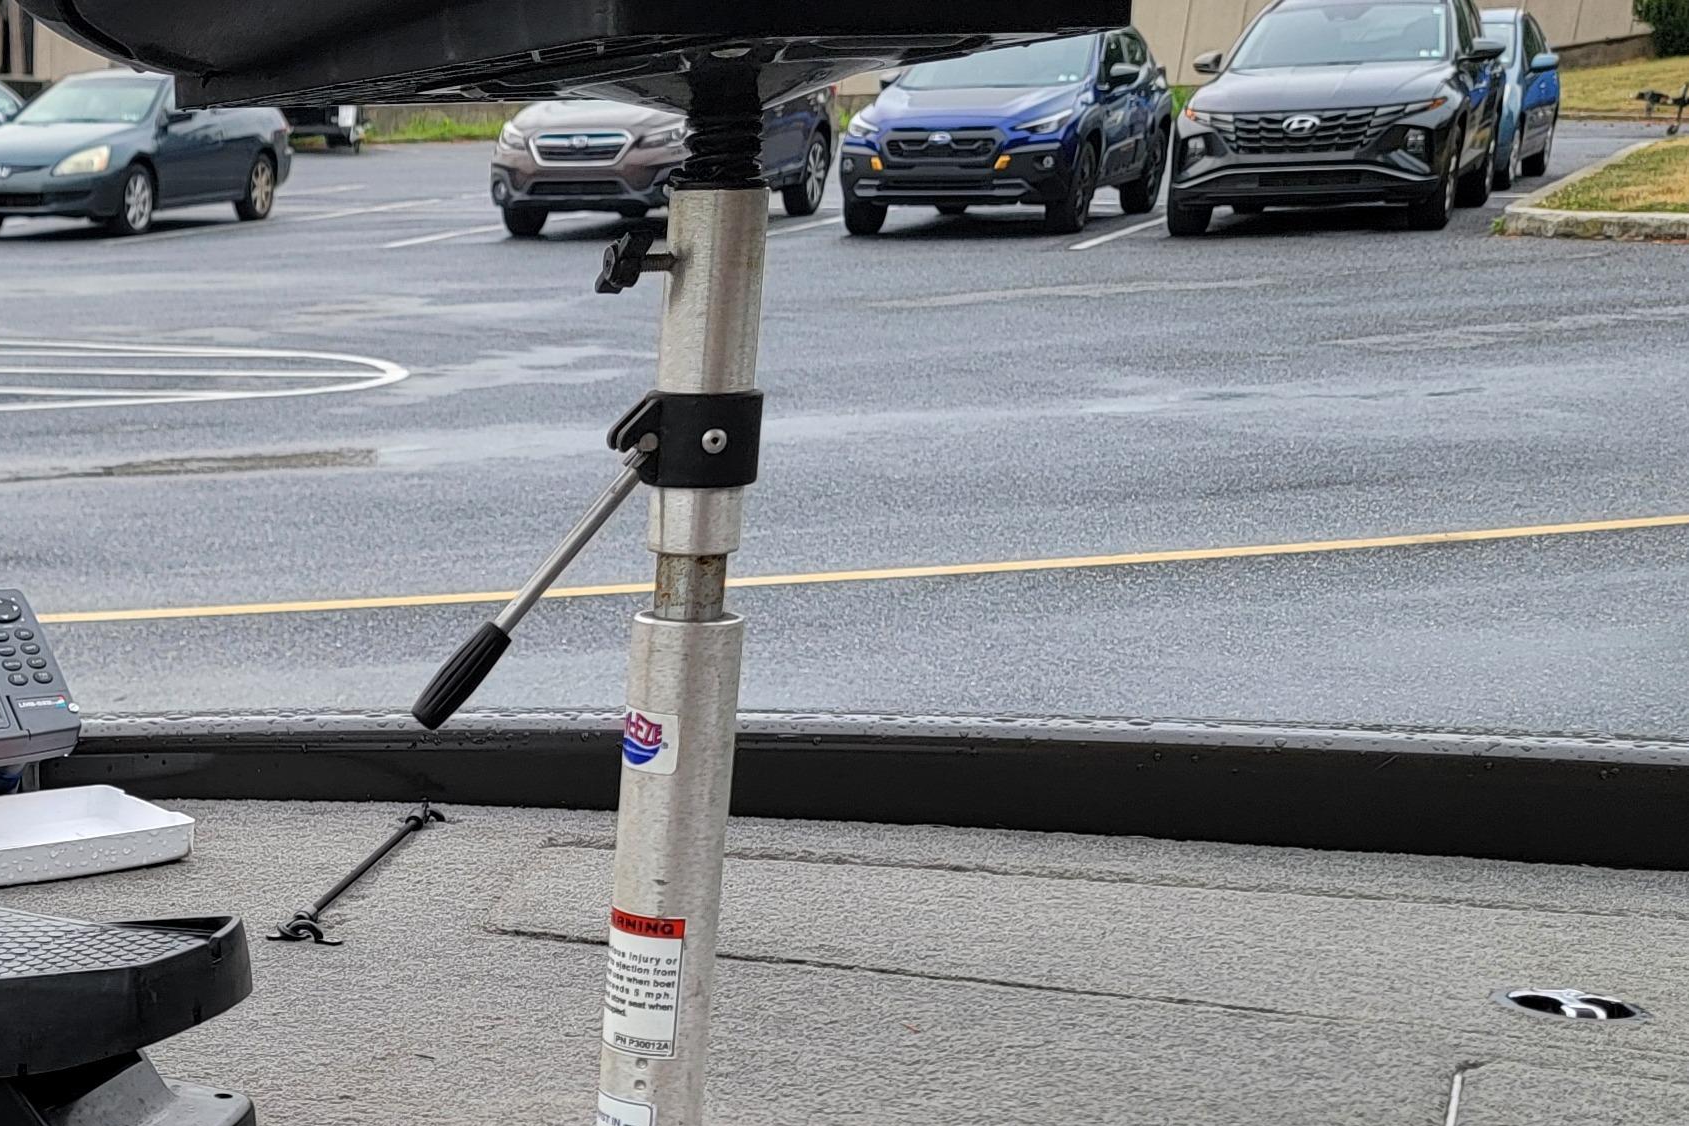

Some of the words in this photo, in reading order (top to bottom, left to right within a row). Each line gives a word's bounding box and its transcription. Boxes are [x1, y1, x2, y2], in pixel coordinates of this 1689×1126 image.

[665, 958, 678, 966] or
[653, 967, 677, 977] from
[626, 976, 651, 987] when
[653, 979, 675, 989] boat
[615, 1035, 627, 1045] PN
